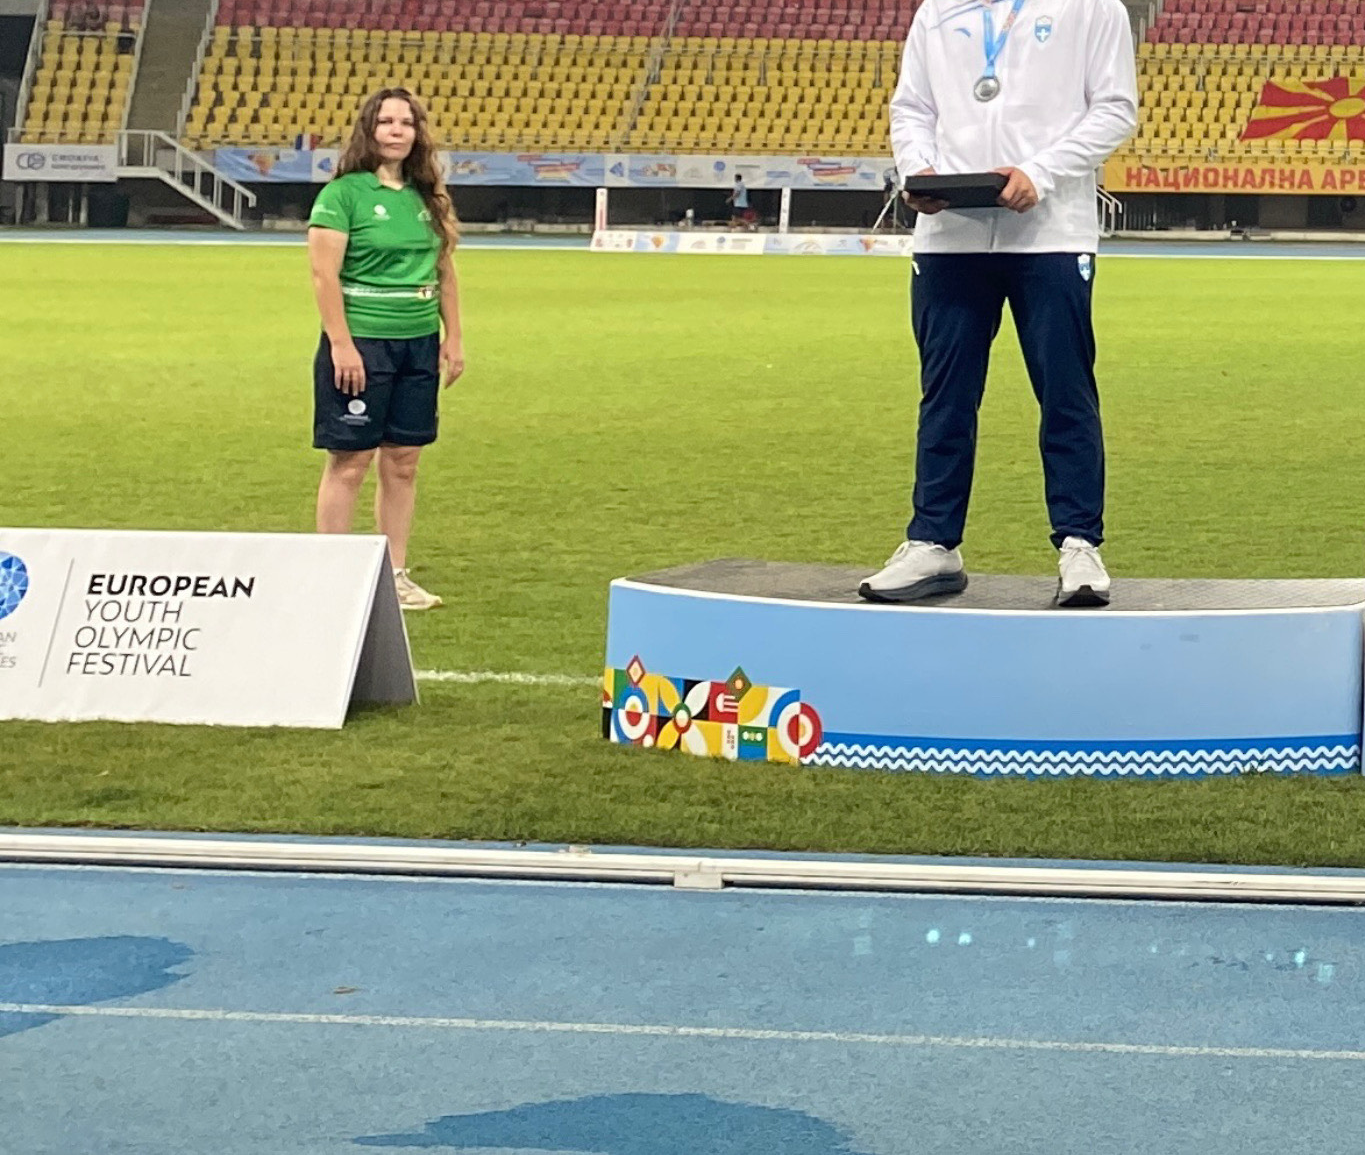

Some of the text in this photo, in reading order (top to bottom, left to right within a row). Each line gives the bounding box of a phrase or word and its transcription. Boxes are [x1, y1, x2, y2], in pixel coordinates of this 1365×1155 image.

[1125, 166, 1313, 191] НАЦИОНАЛНА
[87, 574, 256, 599] EUROPEAN
[84, 600, 184, 624] YOUTH
[74, 626, 201, 651] OLYMPIC
[66, 652, 193, 678] FESTIVAL
